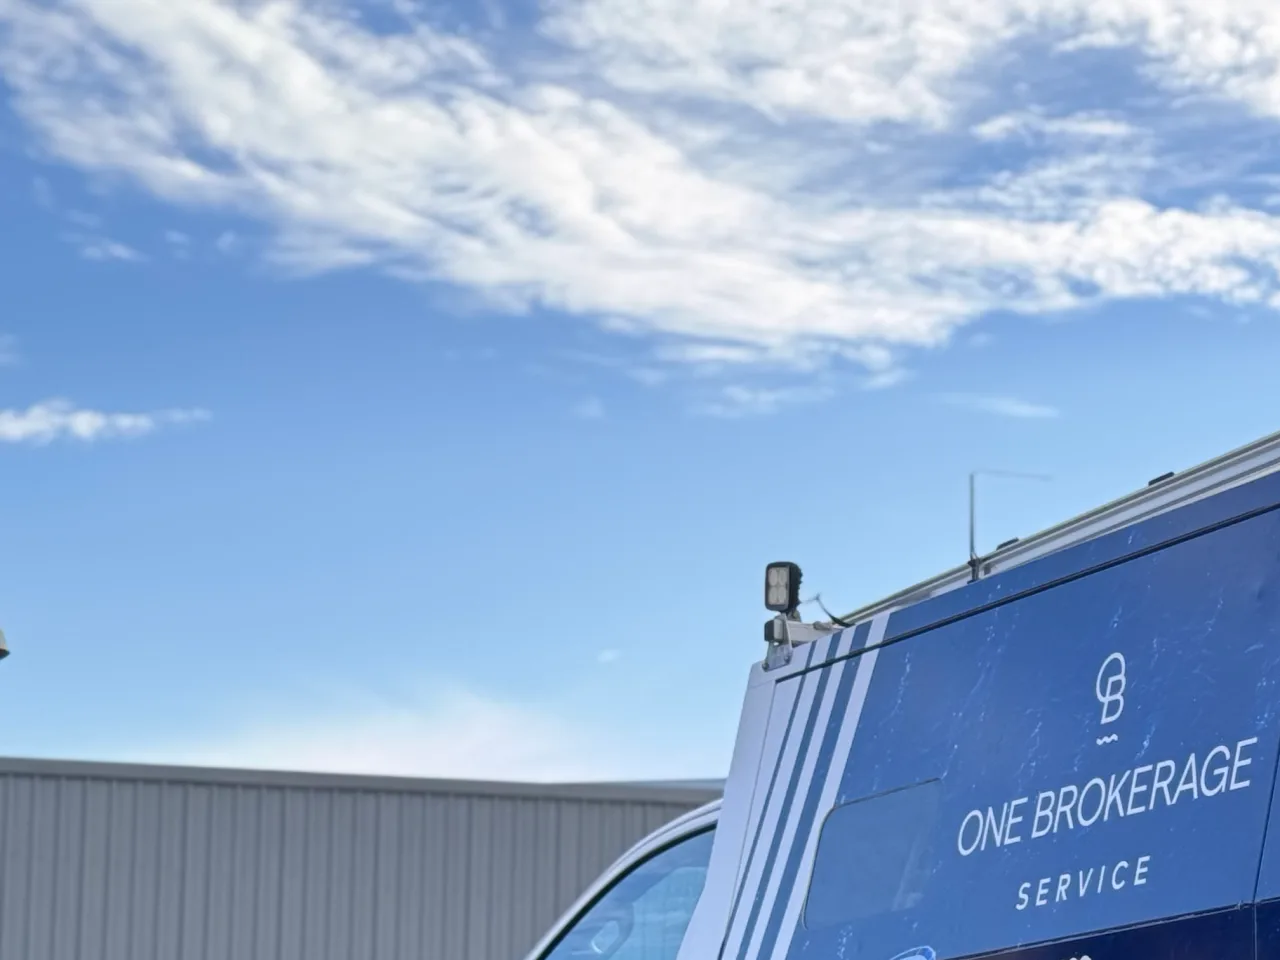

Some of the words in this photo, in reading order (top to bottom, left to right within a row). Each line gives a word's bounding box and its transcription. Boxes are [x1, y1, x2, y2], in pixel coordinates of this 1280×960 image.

[957, 796, 1028, 857] ONE
[1031, 736, 1258, 838] BROKERAGE
[1015, 855, 1151, 911] SERVICE
